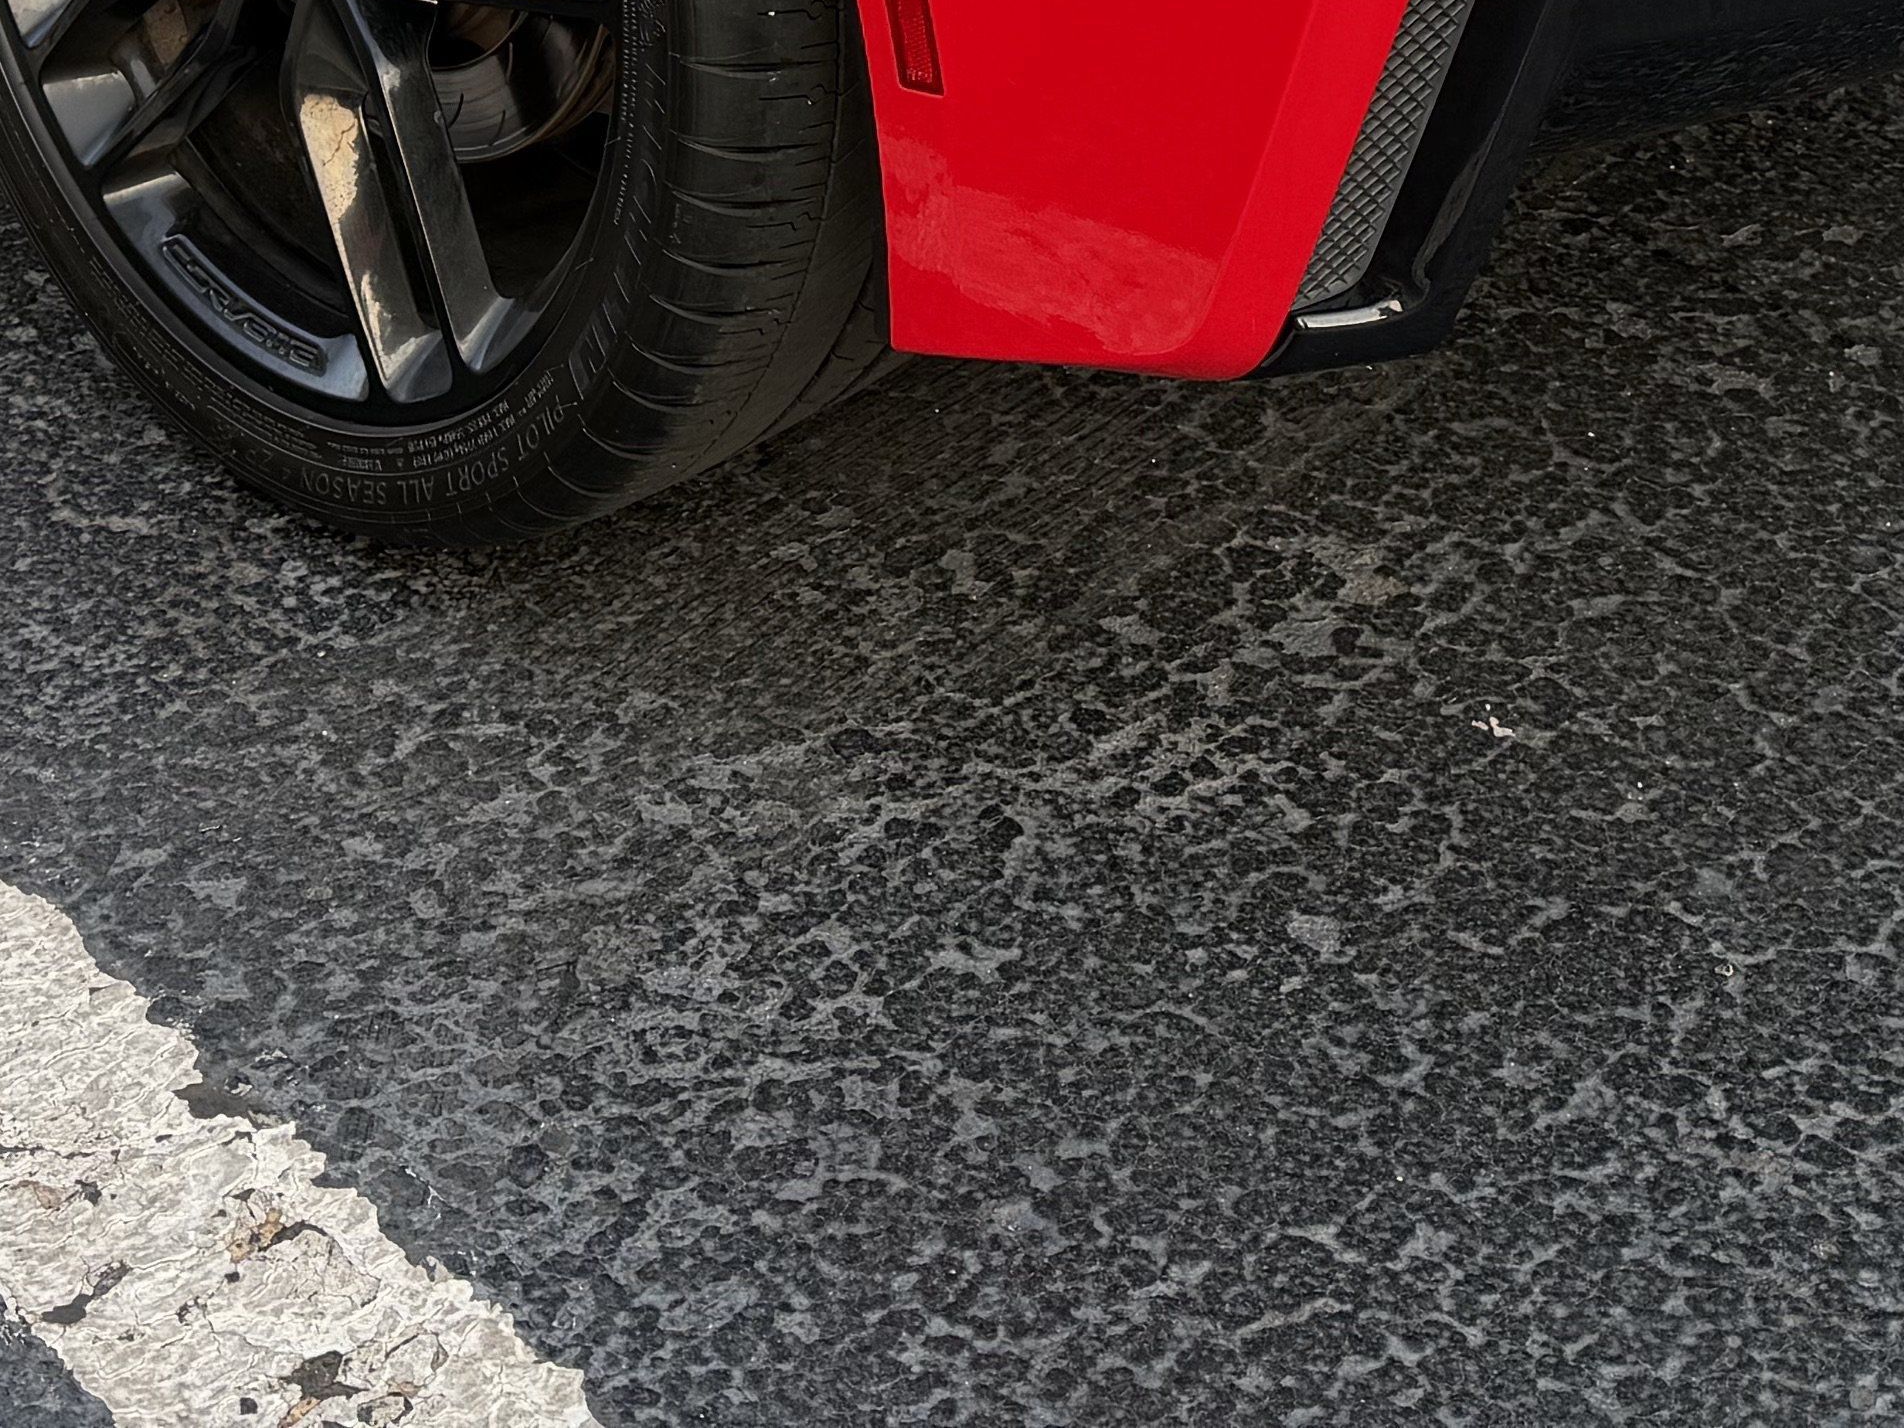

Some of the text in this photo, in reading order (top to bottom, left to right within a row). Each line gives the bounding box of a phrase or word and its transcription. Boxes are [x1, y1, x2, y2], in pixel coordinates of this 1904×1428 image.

[162, 243, 319, 368] CORVETTE
[516, 394, 565, 462] PILOT
[301, 466, 387, 505] SEASON
[397, 476, 434, 505] ALL
[446, 446, 509, 497] SPORT
